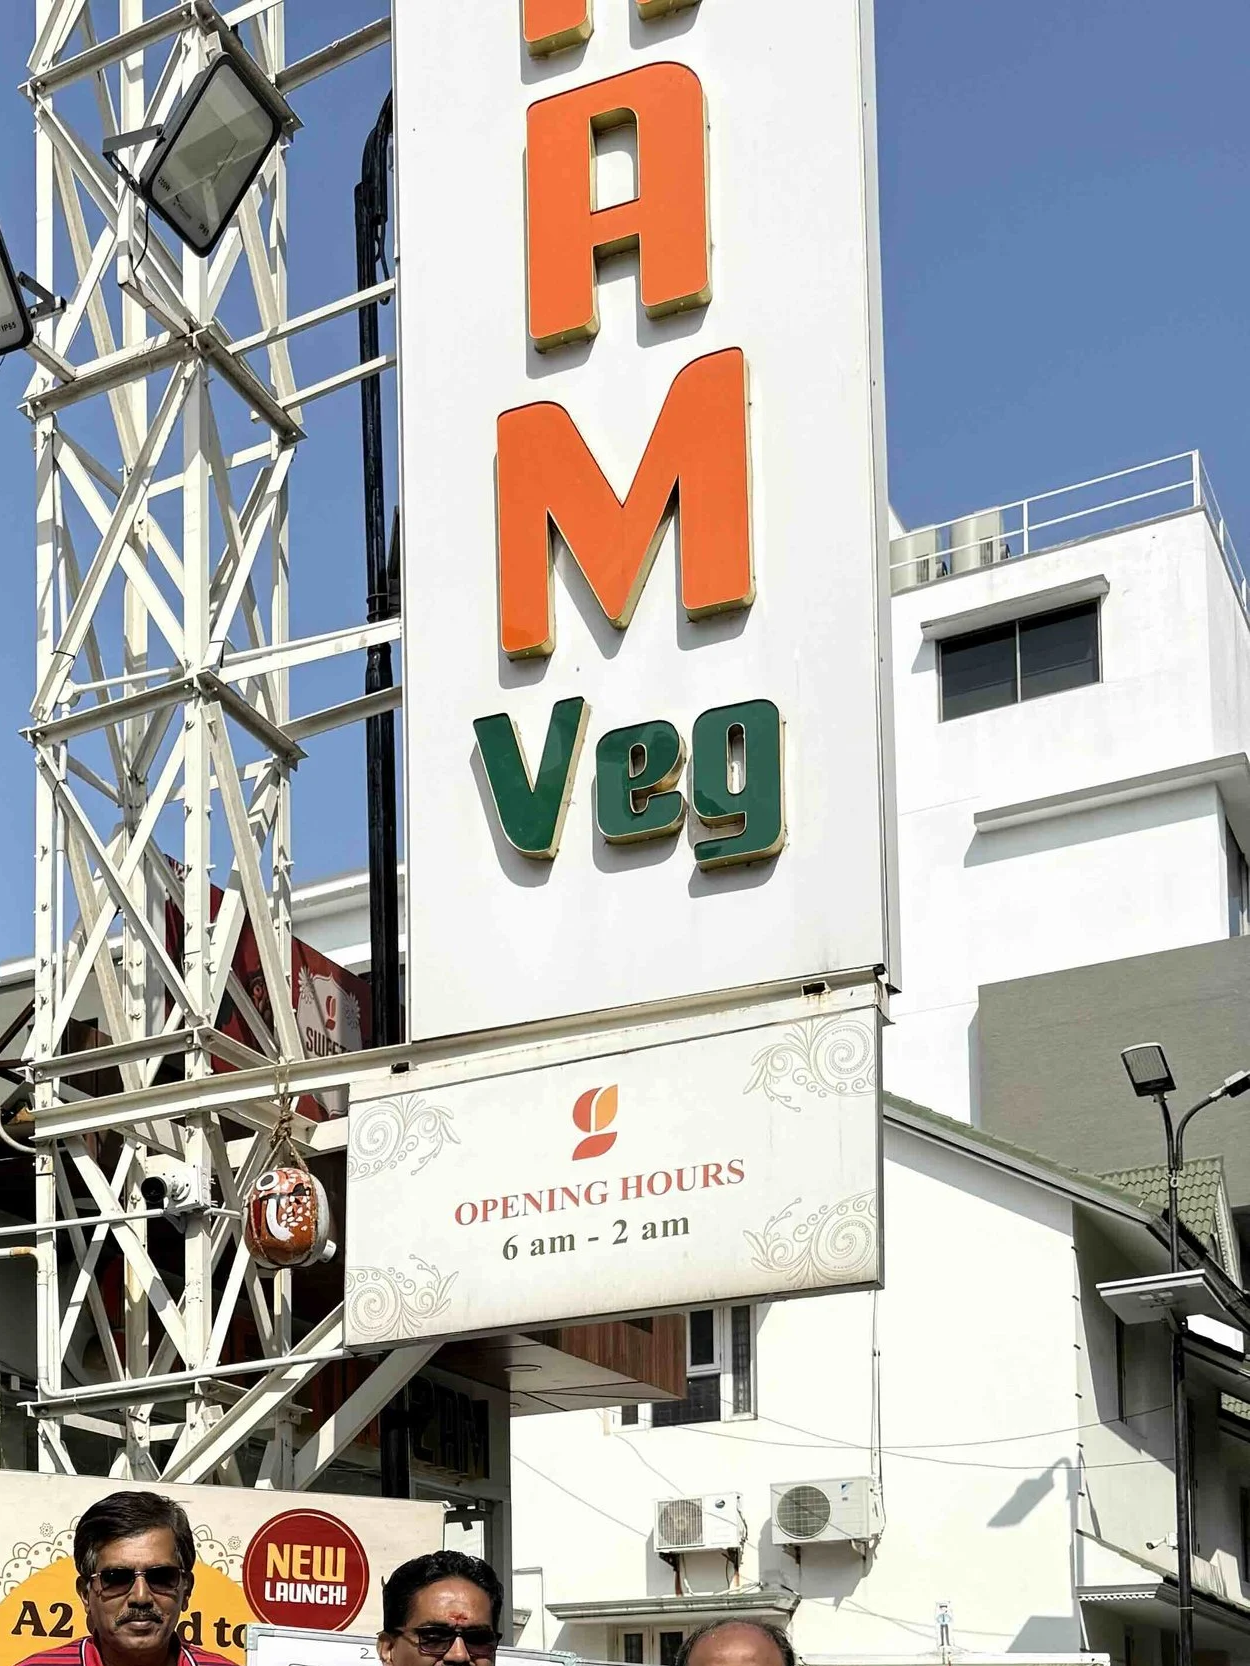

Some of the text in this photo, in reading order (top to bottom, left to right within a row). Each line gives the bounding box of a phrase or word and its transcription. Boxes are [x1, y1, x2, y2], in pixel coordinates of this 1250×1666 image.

[472, 695, 787, 869] Veg
[454, 1158, 746, 1226] OPENING HOURS
[502, 1234, 519, 1261] 6
[529, 1232, 576, 1257] am
[612, 1219, 628, 1245] 2
[641, 1215, 690, 1241] am
[266, 1542, 346, 1583] NEW
[264, 1581, 347, 1606] LAUNCH!
[11, 1600, 74, 1638] A2
